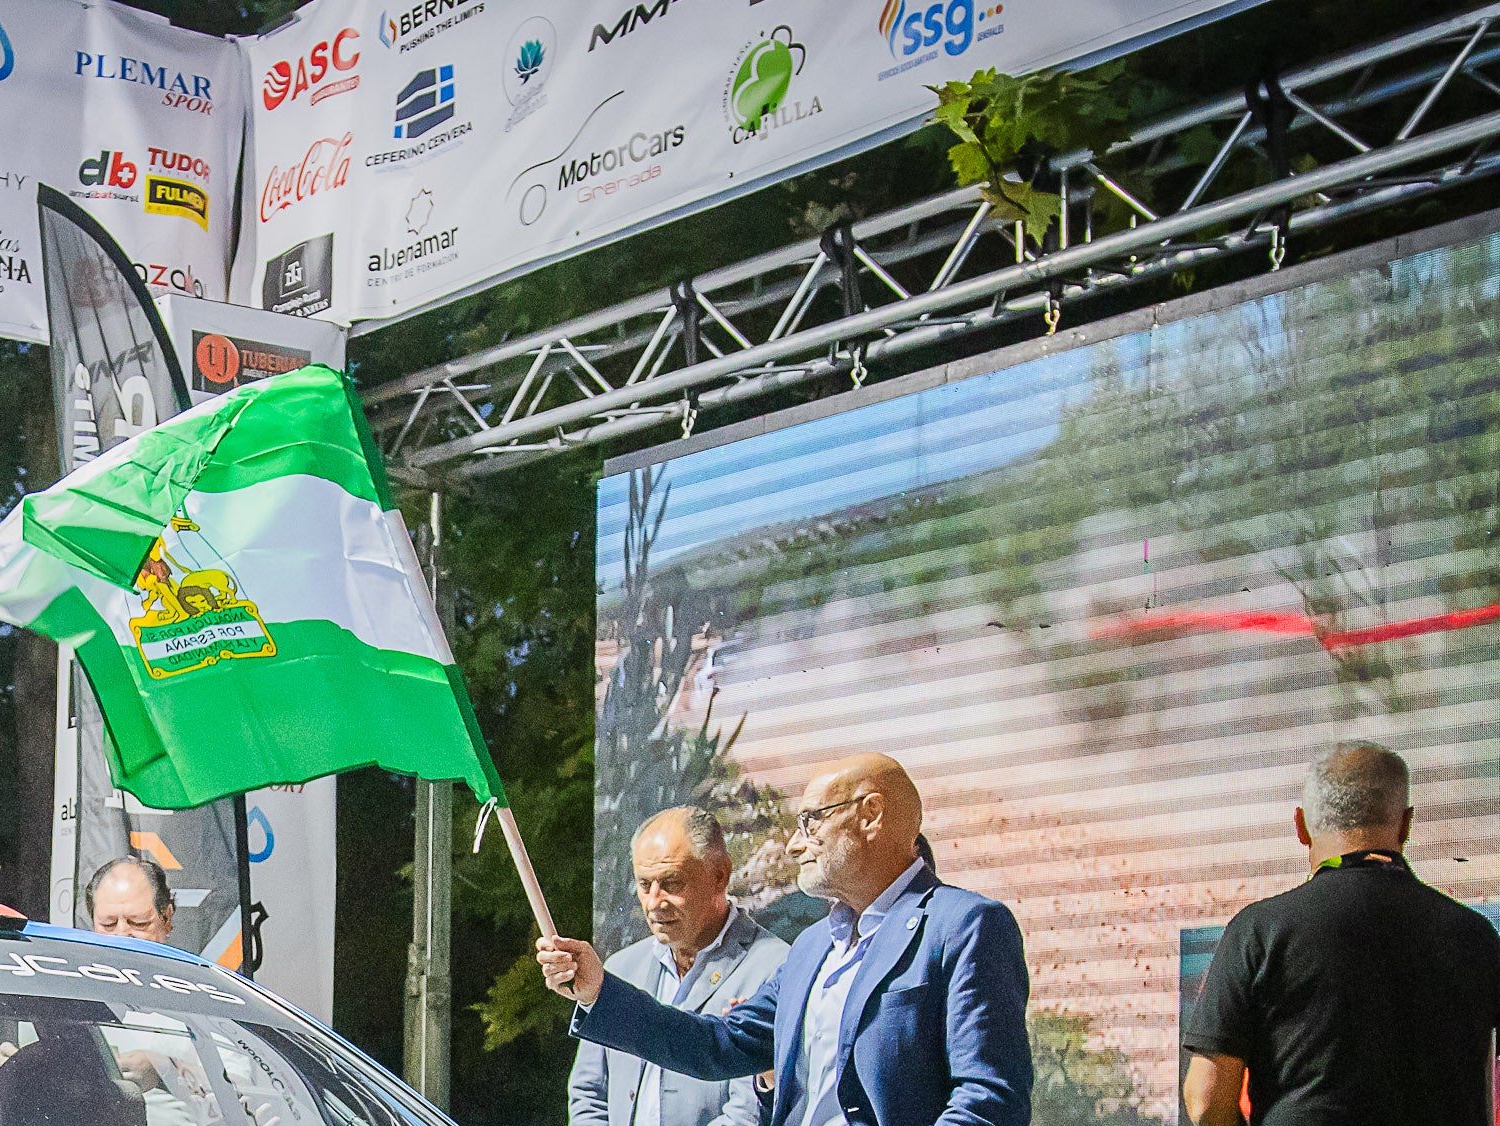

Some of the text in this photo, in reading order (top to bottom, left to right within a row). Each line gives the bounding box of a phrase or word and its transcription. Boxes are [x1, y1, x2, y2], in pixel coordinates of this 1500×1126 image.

[400, 0, 470, 36] BERN
[400, 3, 485, 54] PUSHING THE LIMITS
[587, 0, 679, 52] MM
[75, 50, 213, 101] PLEMAR
[291, 28, 360, 101] ASC
[161, 92, 214, 116] SPOR
[365, 143, 426, 167] CEFERINO
[427, 121, 473, 150] CERVERA
[557, 123, 686, 192] MotorCars
[576, 162, 664, 204] Granada
